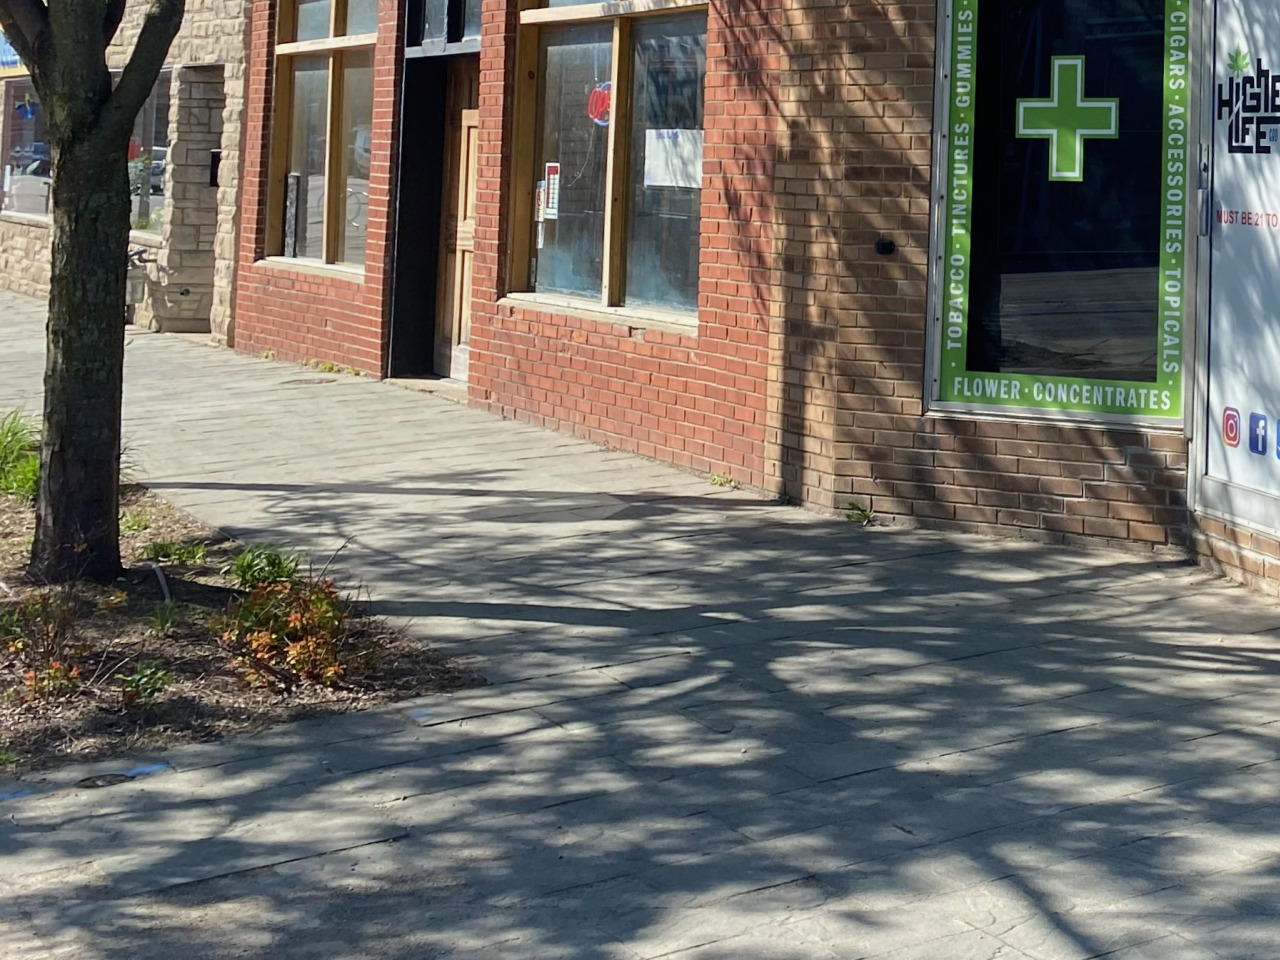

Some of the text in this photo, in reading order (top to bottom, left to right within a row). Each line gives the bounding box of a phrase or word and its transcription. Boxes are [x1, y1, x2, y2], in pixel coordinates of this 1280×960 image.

[955, 9, 973, 108] GUMMIES
[1168, 11, 1187, 90] CIGARS
[951, 122, 970, 236] TINCTURES
[1165, 104, 1185, 253] ACCESSORIES
[1216, 210, 1239, 224] MUST
[1241, 211, 1253, 226] BE
[1254, 212, 1264, 227] 21
[1266, 213, 1278, 228] TO
[946, 254, 965, 350] TOBACCO
[1162, 268, 1181, 373] TOPICALS
[953, 376, 1171, 411] FLOWER CONCENTRATES
